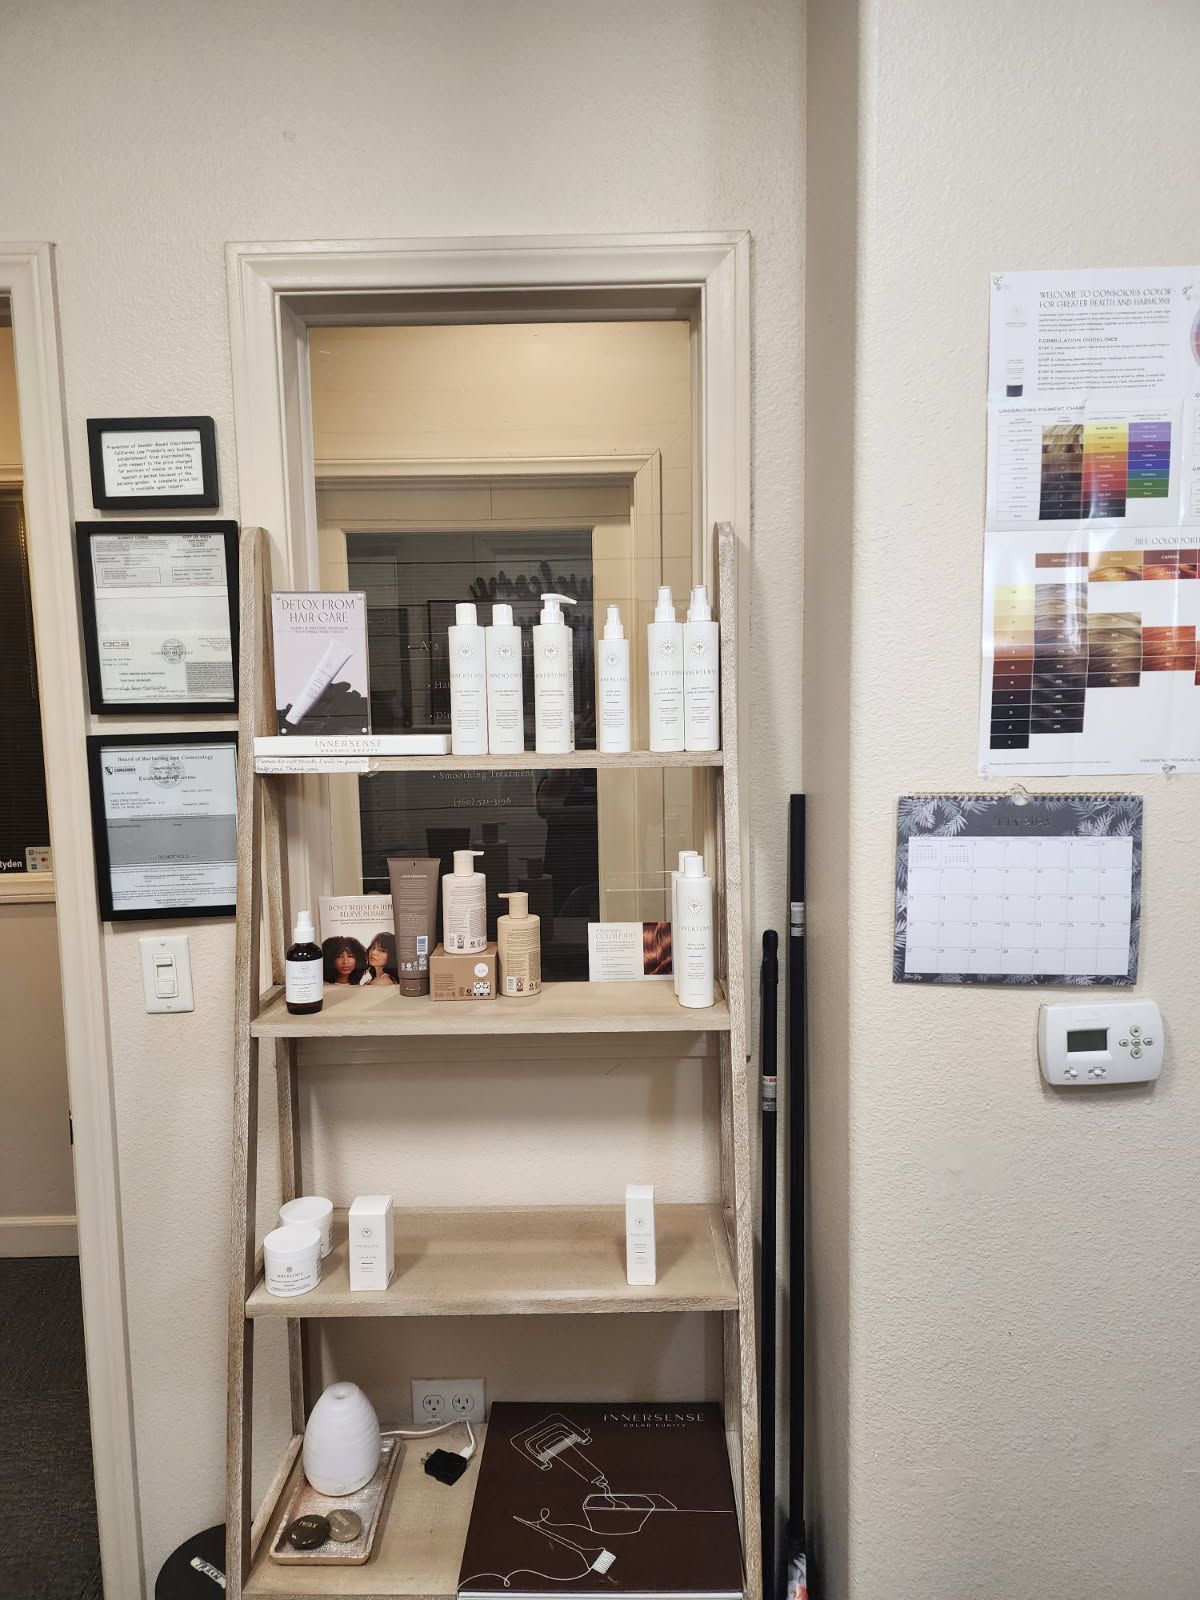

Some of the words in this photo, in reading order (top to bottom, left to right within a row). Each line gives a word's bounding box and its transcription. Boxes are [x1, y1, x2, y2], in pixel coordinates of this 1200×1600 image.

[1039, 290, 1078, 299] WELCOME
[1080, 289, 1091, 298] TO
[1092, 288, 1141, 298] CONSCIOUS
[1143, 288, 1171, 297] COLOR
[1039, 301, 1055, 309] FOR
[1056, 300, 1088, 308] GREATER
[1089, 299, 1116, 307] HEALTH
[1116, 298, 1132, 306] AND
[1134, 298, 1170, 306] HARMONY
[281, 599, 318, 610] DETOX
[322, 598, 355, 610] FROM
[290, 612, 314, 623] HAIR
[318, 611, 348, 623] CARE
[315, 739, 383, 748] INNERSENSE
[440, 770, 487, 780] Smoothing
[491, 769, 535, 778] Treatment
[604, 1412, 704, 1422] INNERSENSE
[298, 1520, 318, 1528] relax
